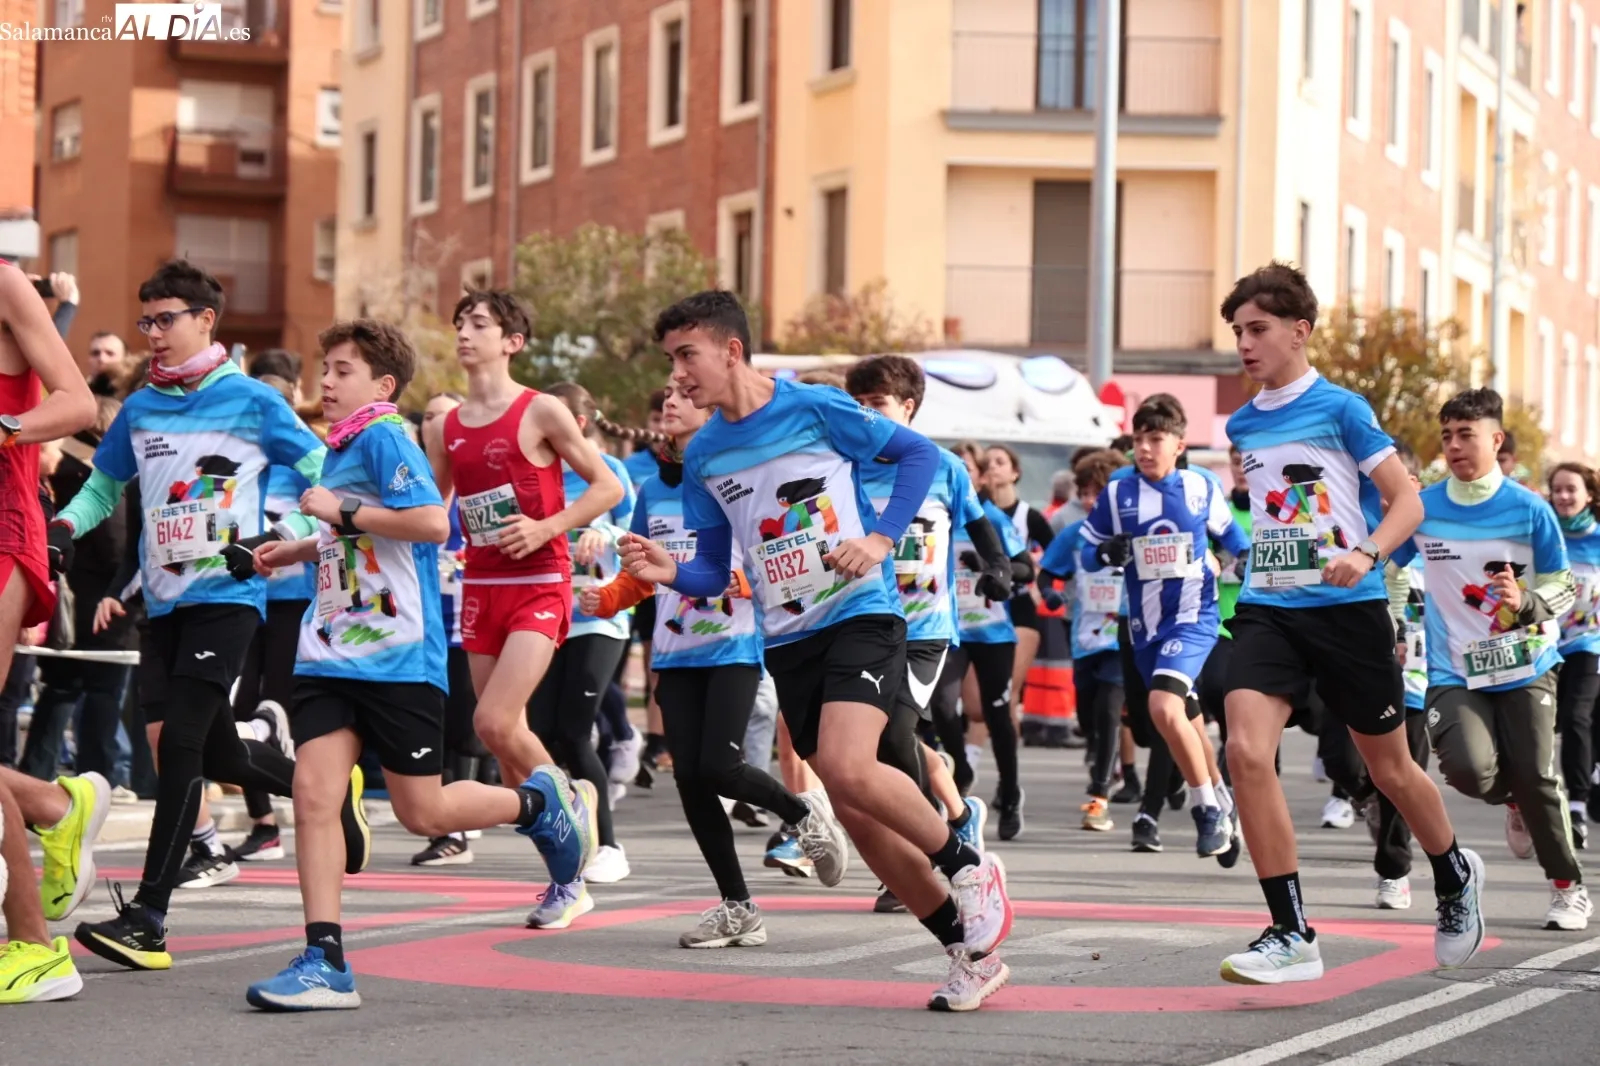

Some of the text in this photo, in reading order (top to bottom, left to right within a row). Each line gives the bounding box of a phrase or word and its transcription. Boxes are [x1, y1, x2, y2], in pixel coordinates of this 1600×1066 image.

[465, 491, 507, 507] SETEL
[161, 502, 207, 518] SETEL
[464, 504, 501, 532] 6124
[157, 516, 194, 545] 6142
[1262, 528, 1310, 540] SETEL
[665, 540, 695, 551] SETE
[766, 532, 817, 555] SETEL
[1255, 541, 1299, 567] 6230
[1143, 545, 1177, 565] 6160
[764, 548, 810, 585] 6132
[1478, 633, 1521, 650] SETEL
[1471, 646, 1518, 673] 6208
